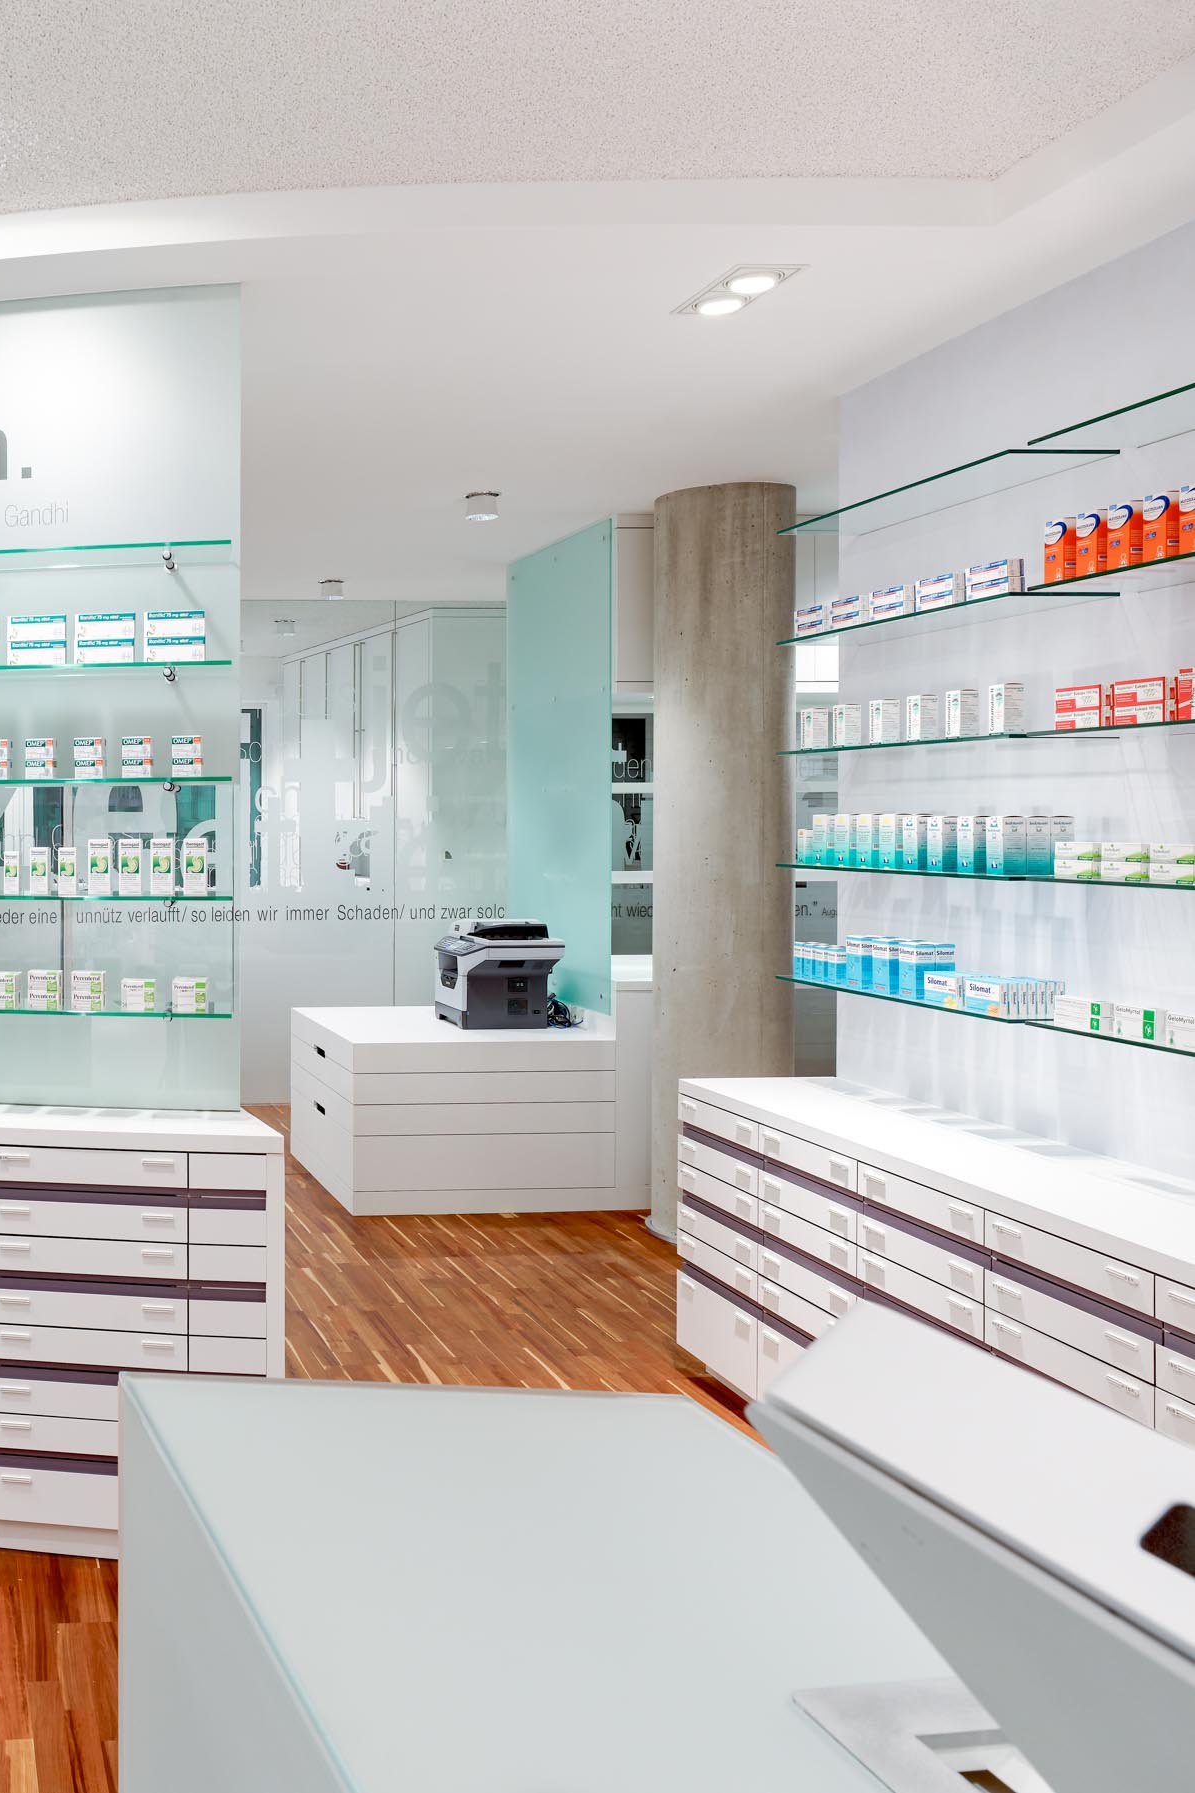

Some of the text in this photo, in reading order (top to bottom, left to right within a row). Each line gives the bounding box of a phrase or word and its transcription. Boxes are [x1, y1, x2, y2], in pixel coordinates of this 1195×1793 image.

[4, 501, 70, 528] Gandhi
[29, 909, 57, 924] eine
[76, 907, 122, 924] unnütz
[191, 909, 206, 922] so
[211, 905, 250, 922] leiden
[258, 904, 277, 921] wir
[286, 904, 329, 921] immer
[410, 904, 435, 920] und
[440, 906, 472, 920] zwar
[927, 976, 948, 987] Silomat
[969, 983, 991, 994] Silomat
